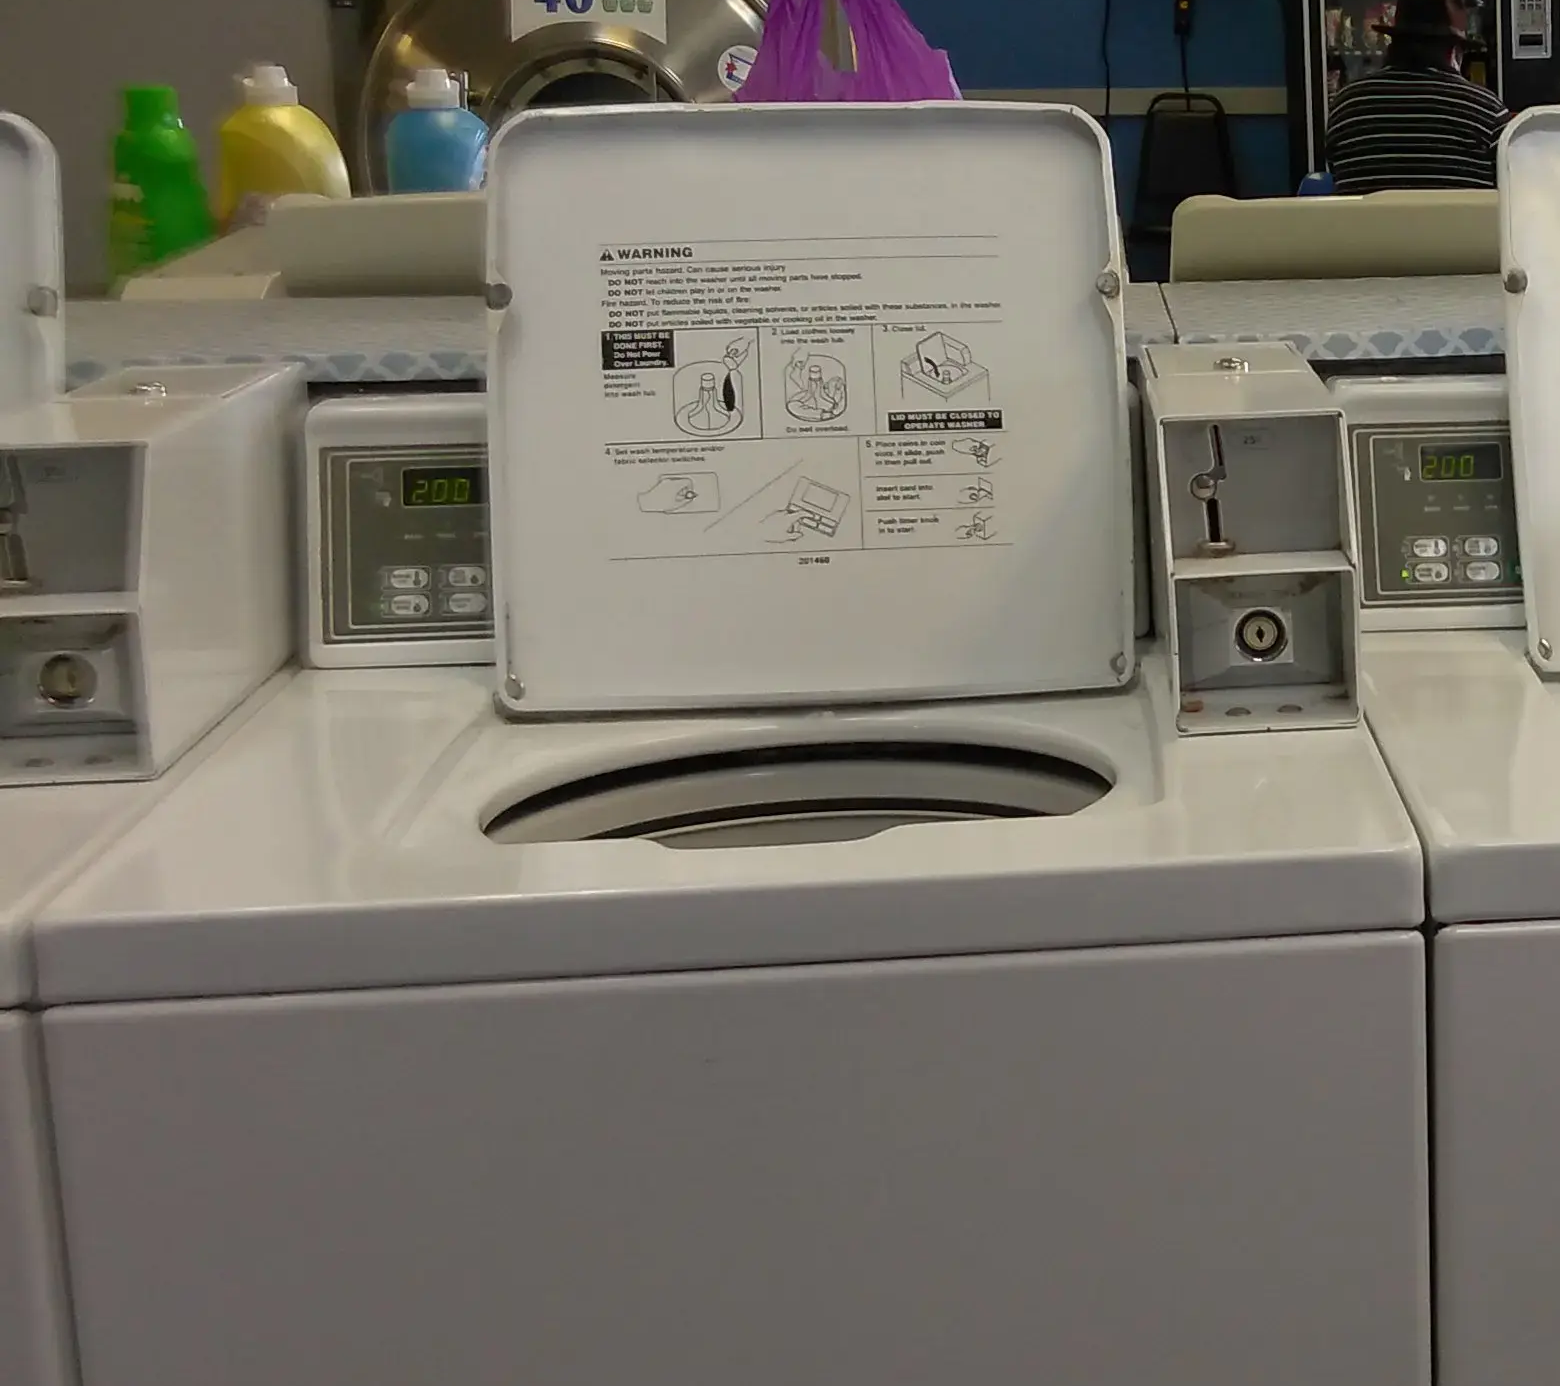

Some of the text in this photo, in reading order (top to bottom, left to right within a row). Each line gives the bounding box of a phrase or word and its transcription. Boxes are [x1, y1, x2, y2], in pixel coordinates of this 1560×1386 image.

[617, 247, 693, 260] WARNING
[624, 278, 644, 286] NOT
[1423, 455, 1474, 479] 200
[412, 478, 470, 503] 200
